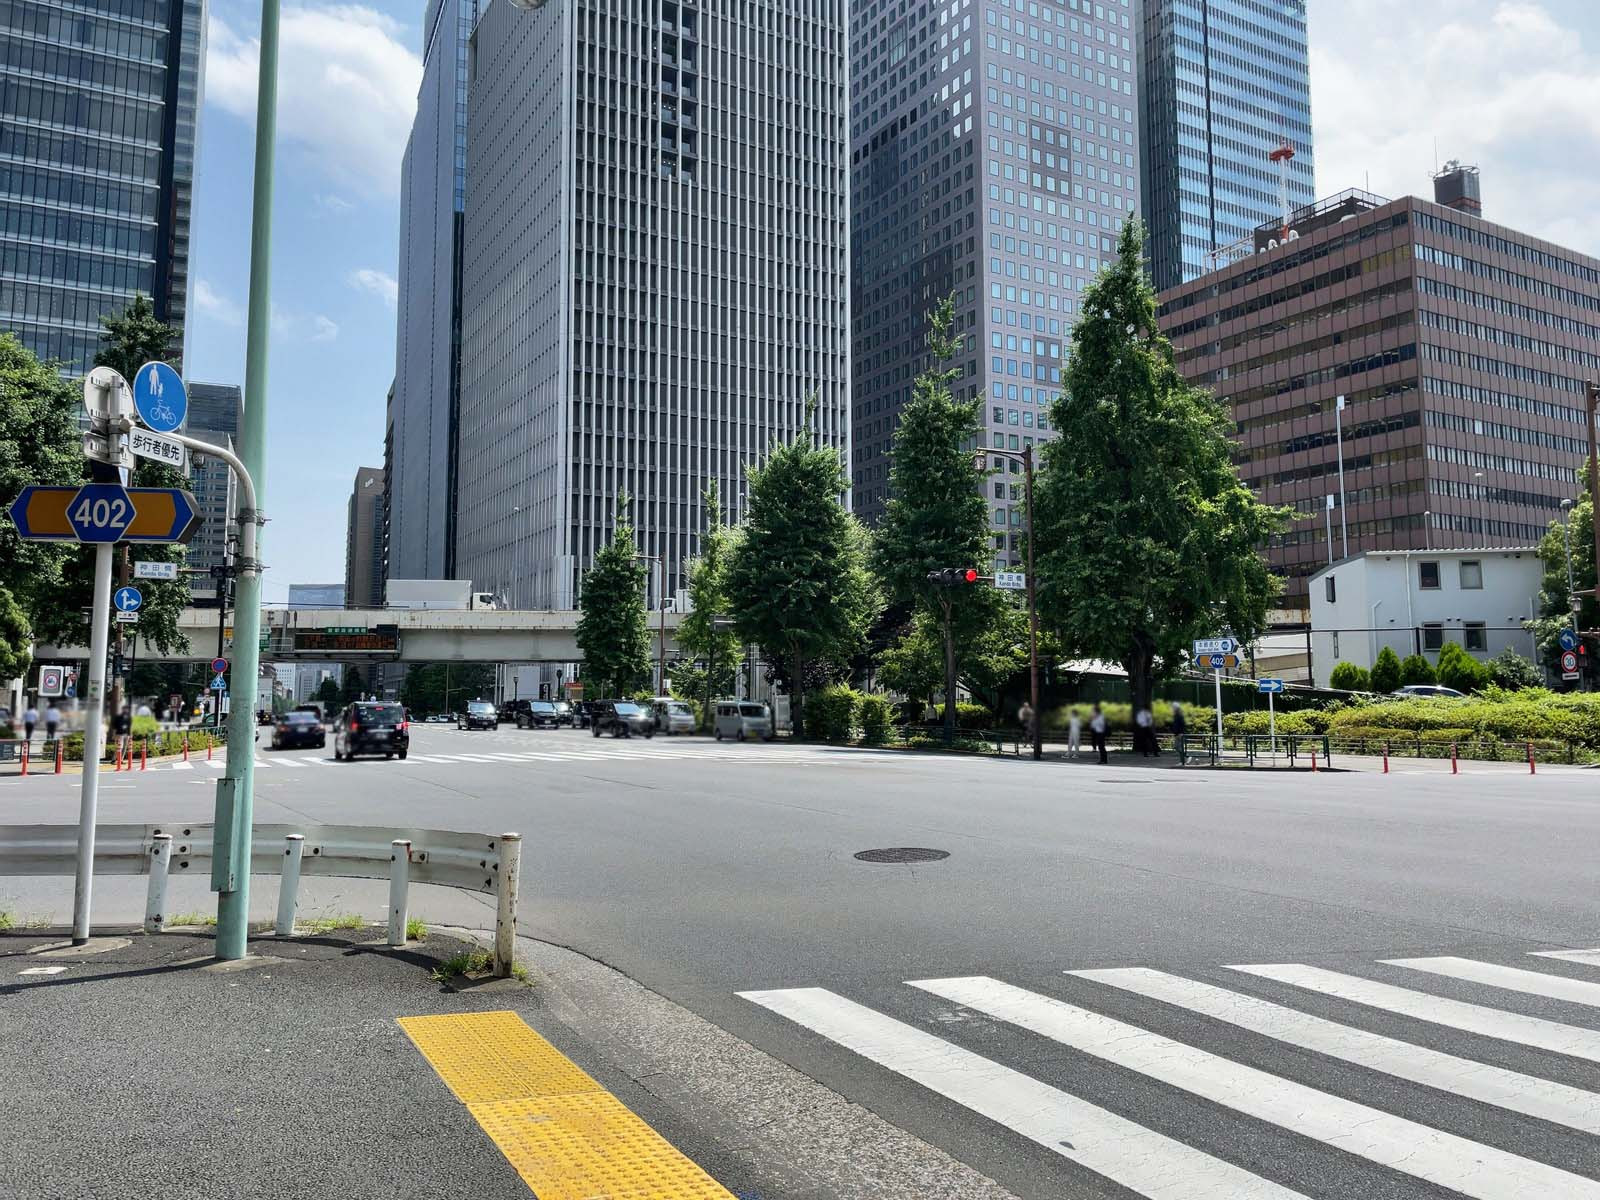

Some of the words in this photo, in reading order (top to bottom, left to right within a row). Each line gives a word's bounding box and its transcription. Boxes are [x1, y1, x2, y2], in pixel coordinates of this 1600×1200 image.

[133, 433, 180, 461] 歩行者優先
[74, 498, 126, 528] 402
[1211, 657, 1224, 665] 402
